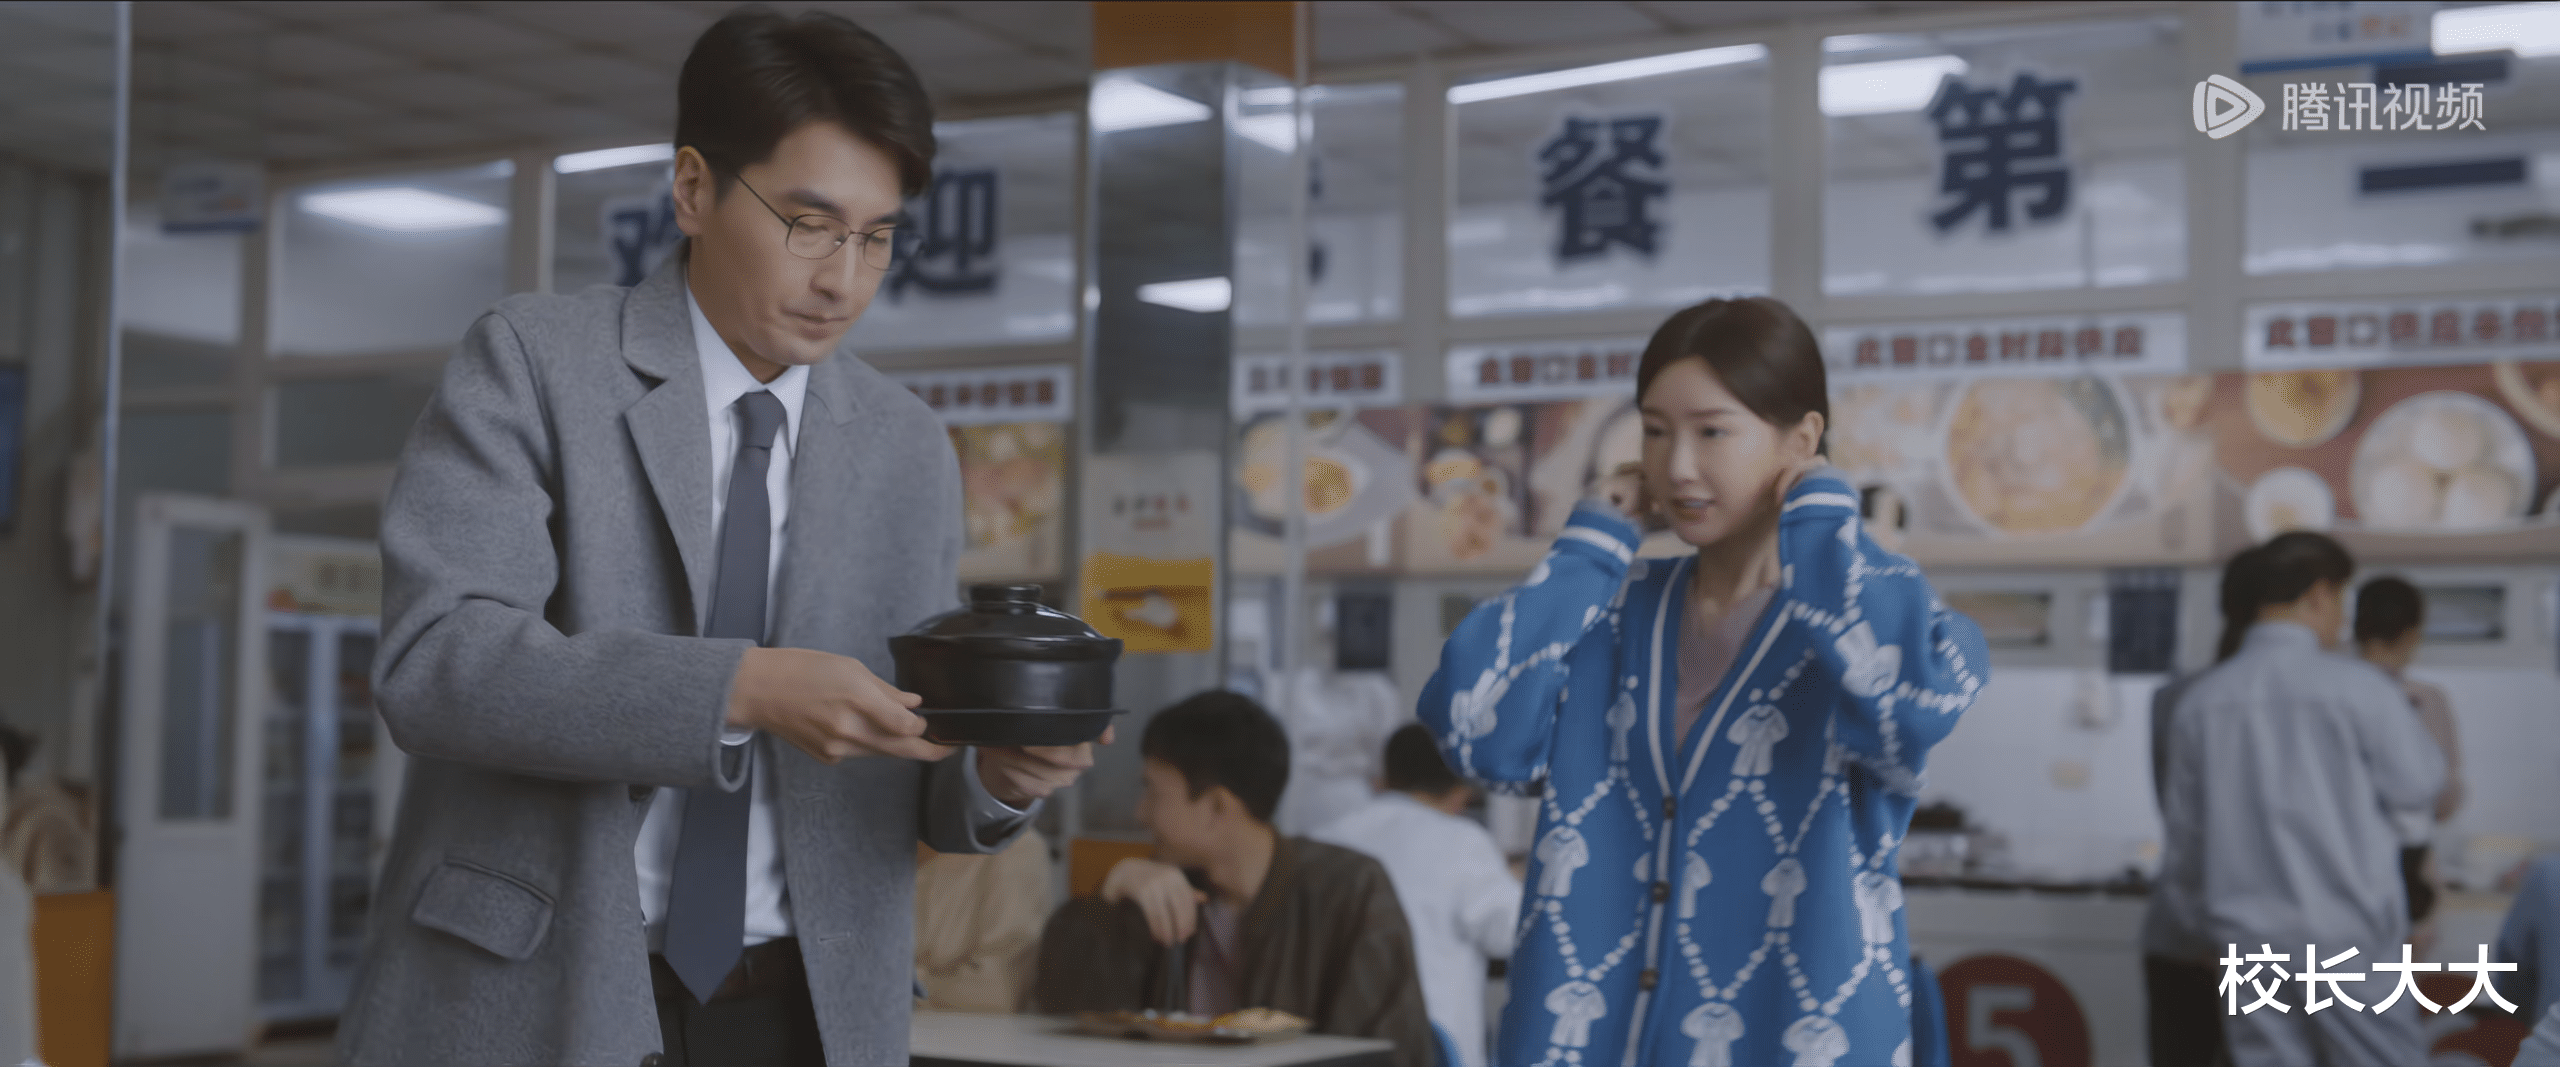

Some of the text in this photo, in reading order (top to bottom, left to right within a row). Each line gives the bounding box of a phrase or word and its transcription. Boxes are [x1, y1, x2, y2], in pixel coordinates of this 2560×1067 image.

[1537, 113, 1671, 261] 餐
[1930, 72, 2079, 236] 第
[1966, 984, 2043, 1066] 5
